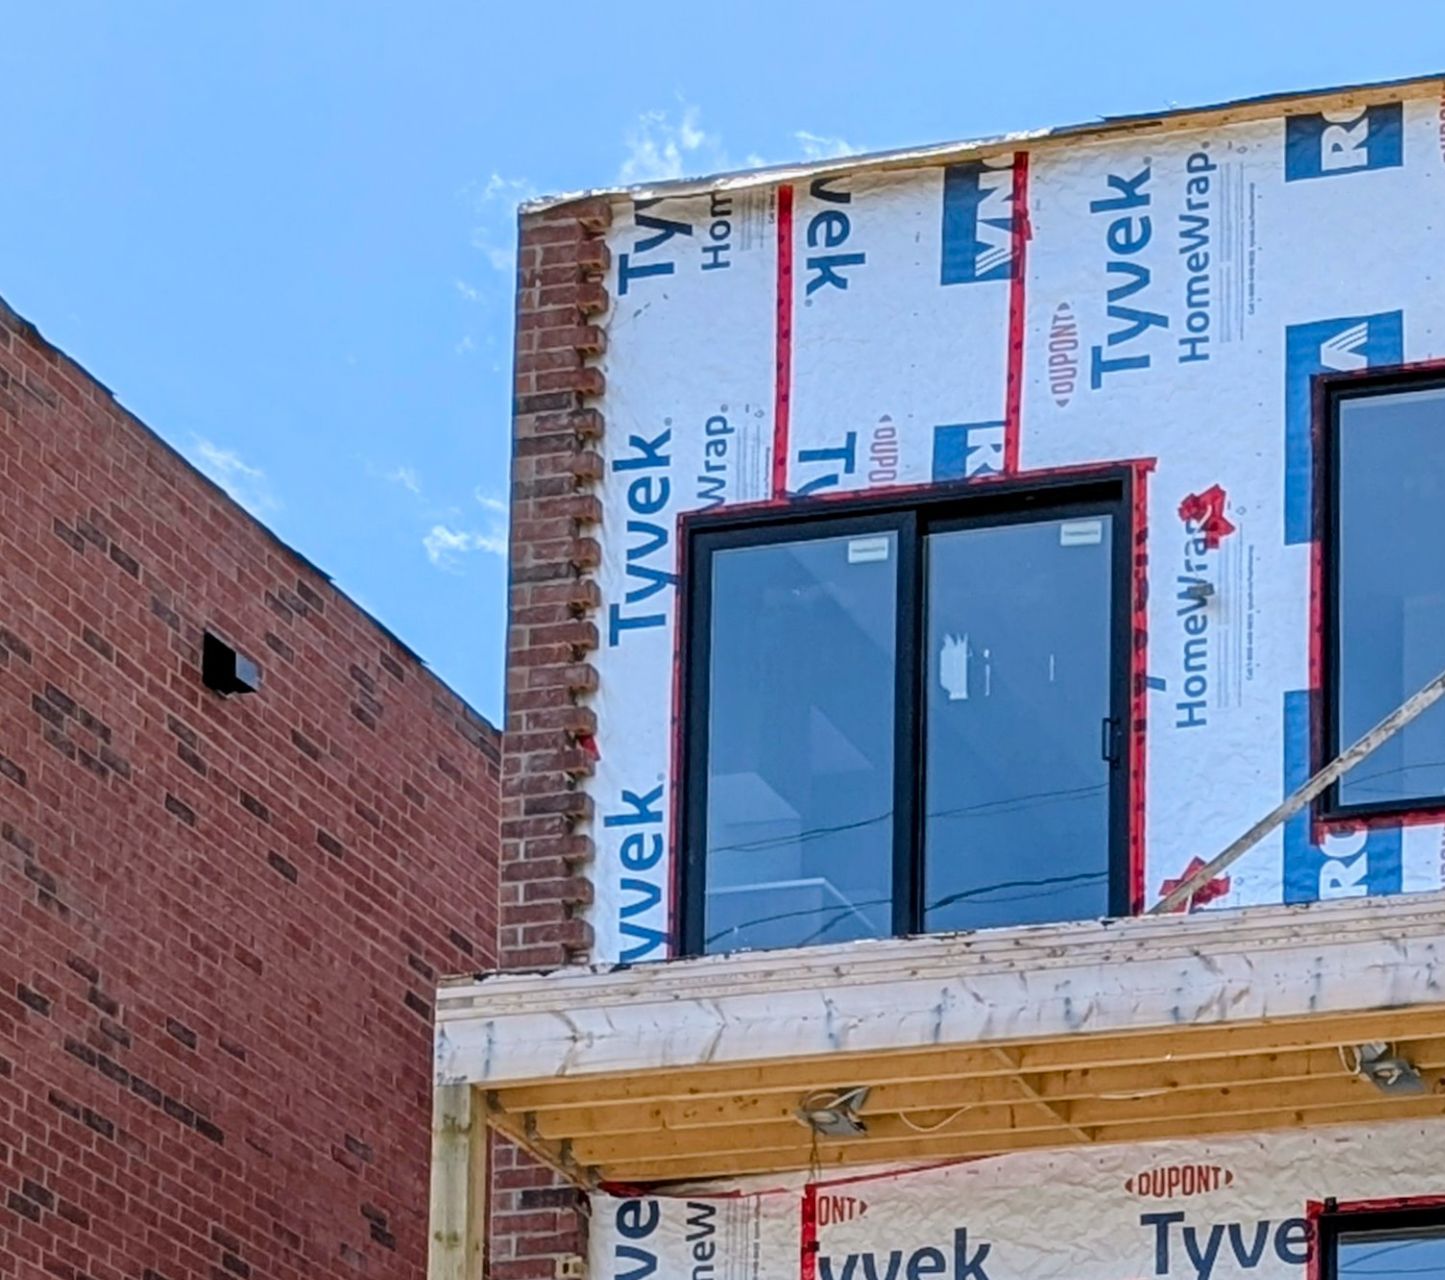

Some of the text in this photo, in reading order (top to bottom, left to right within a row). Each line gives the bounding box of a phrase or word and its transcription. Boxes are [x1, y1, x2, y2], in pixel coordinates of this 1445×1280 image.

[1048, 311, 1078, 402] DUPONT
[1091, 167, 1169, 388] Tyvek
[1179, 152, 1216, 363] HomeWrap
[609, 428, 682, 646] Tyvek
[1176, 505, 1210, 728] HomeWra
[1137, 1165, 1222, 1199] DUPONT
